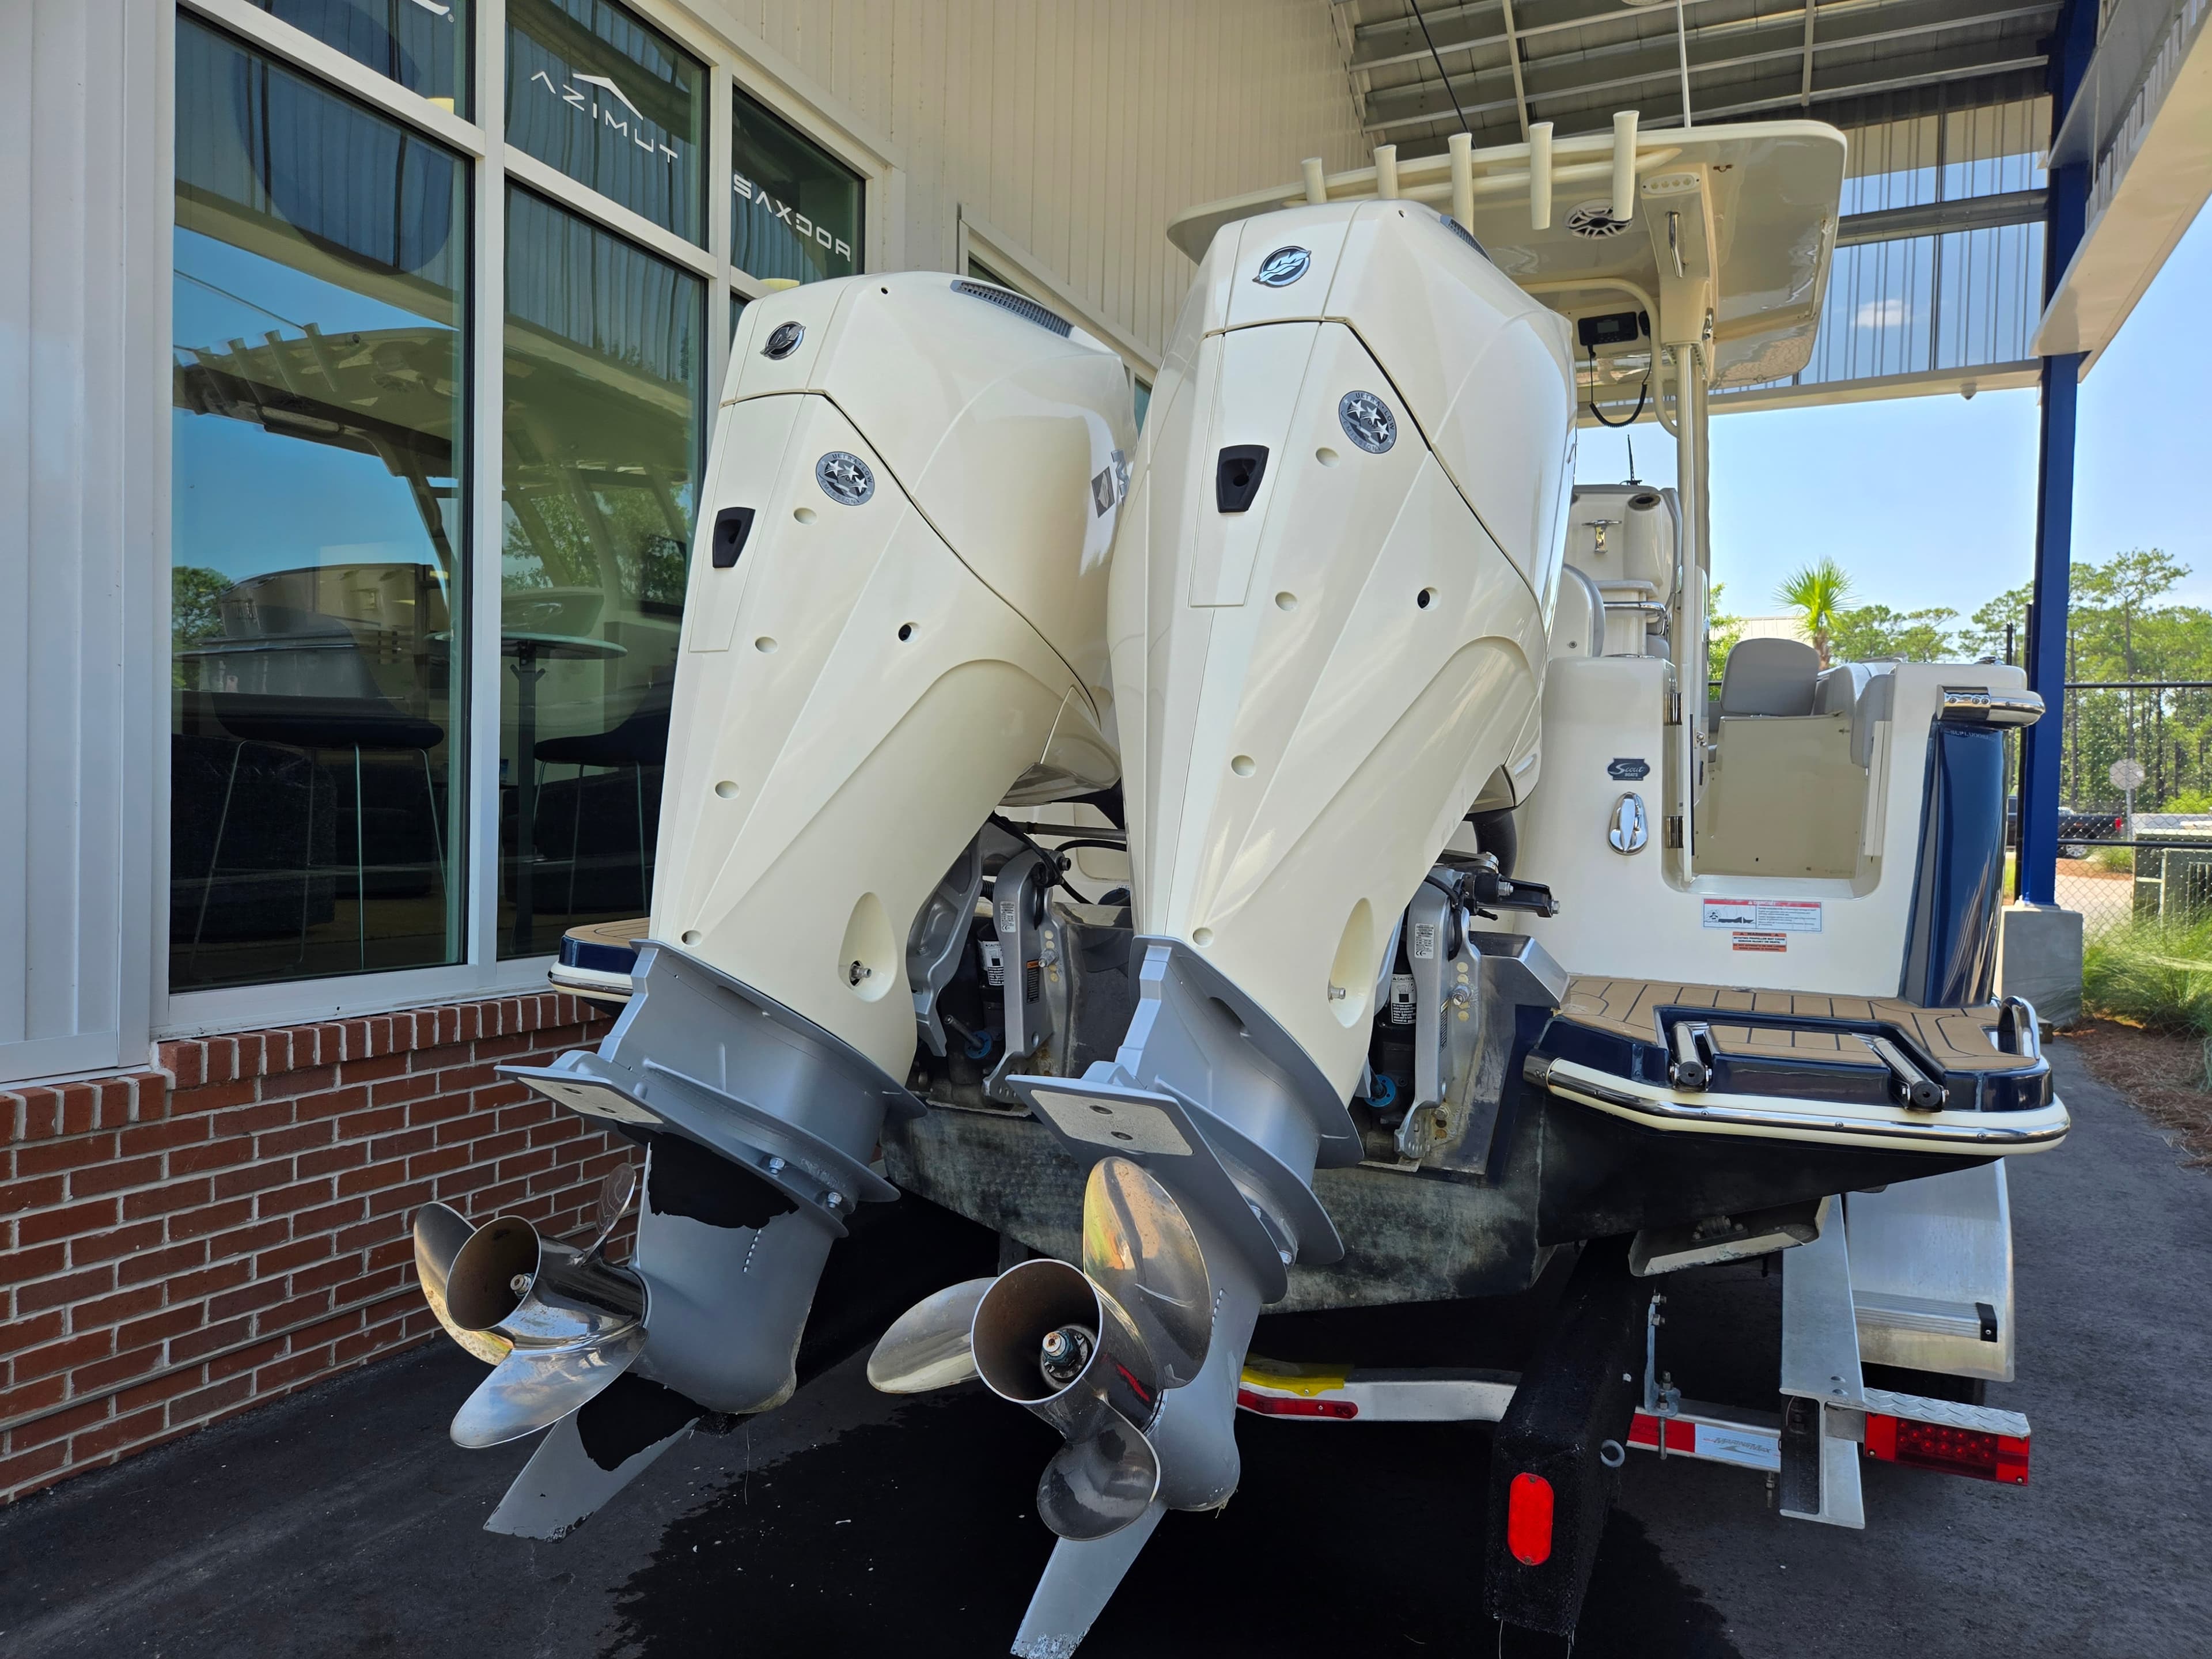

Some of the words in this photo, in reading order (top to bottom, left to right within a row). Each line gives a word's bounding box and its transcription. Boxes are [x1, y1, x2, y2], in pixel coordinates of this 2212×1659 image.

[531, 71, 678, 163] AZIMUT
[733, 173, 851, 263] SAXDOR
[1355, 392, 1380, 407] ULTRA
[1384, 410, 1395, 430] LOW
[832, 453, 857, 464] ULTRA
[861, 467, 873, 483] LOW
[1608, 763, 1646, 775] Scout
